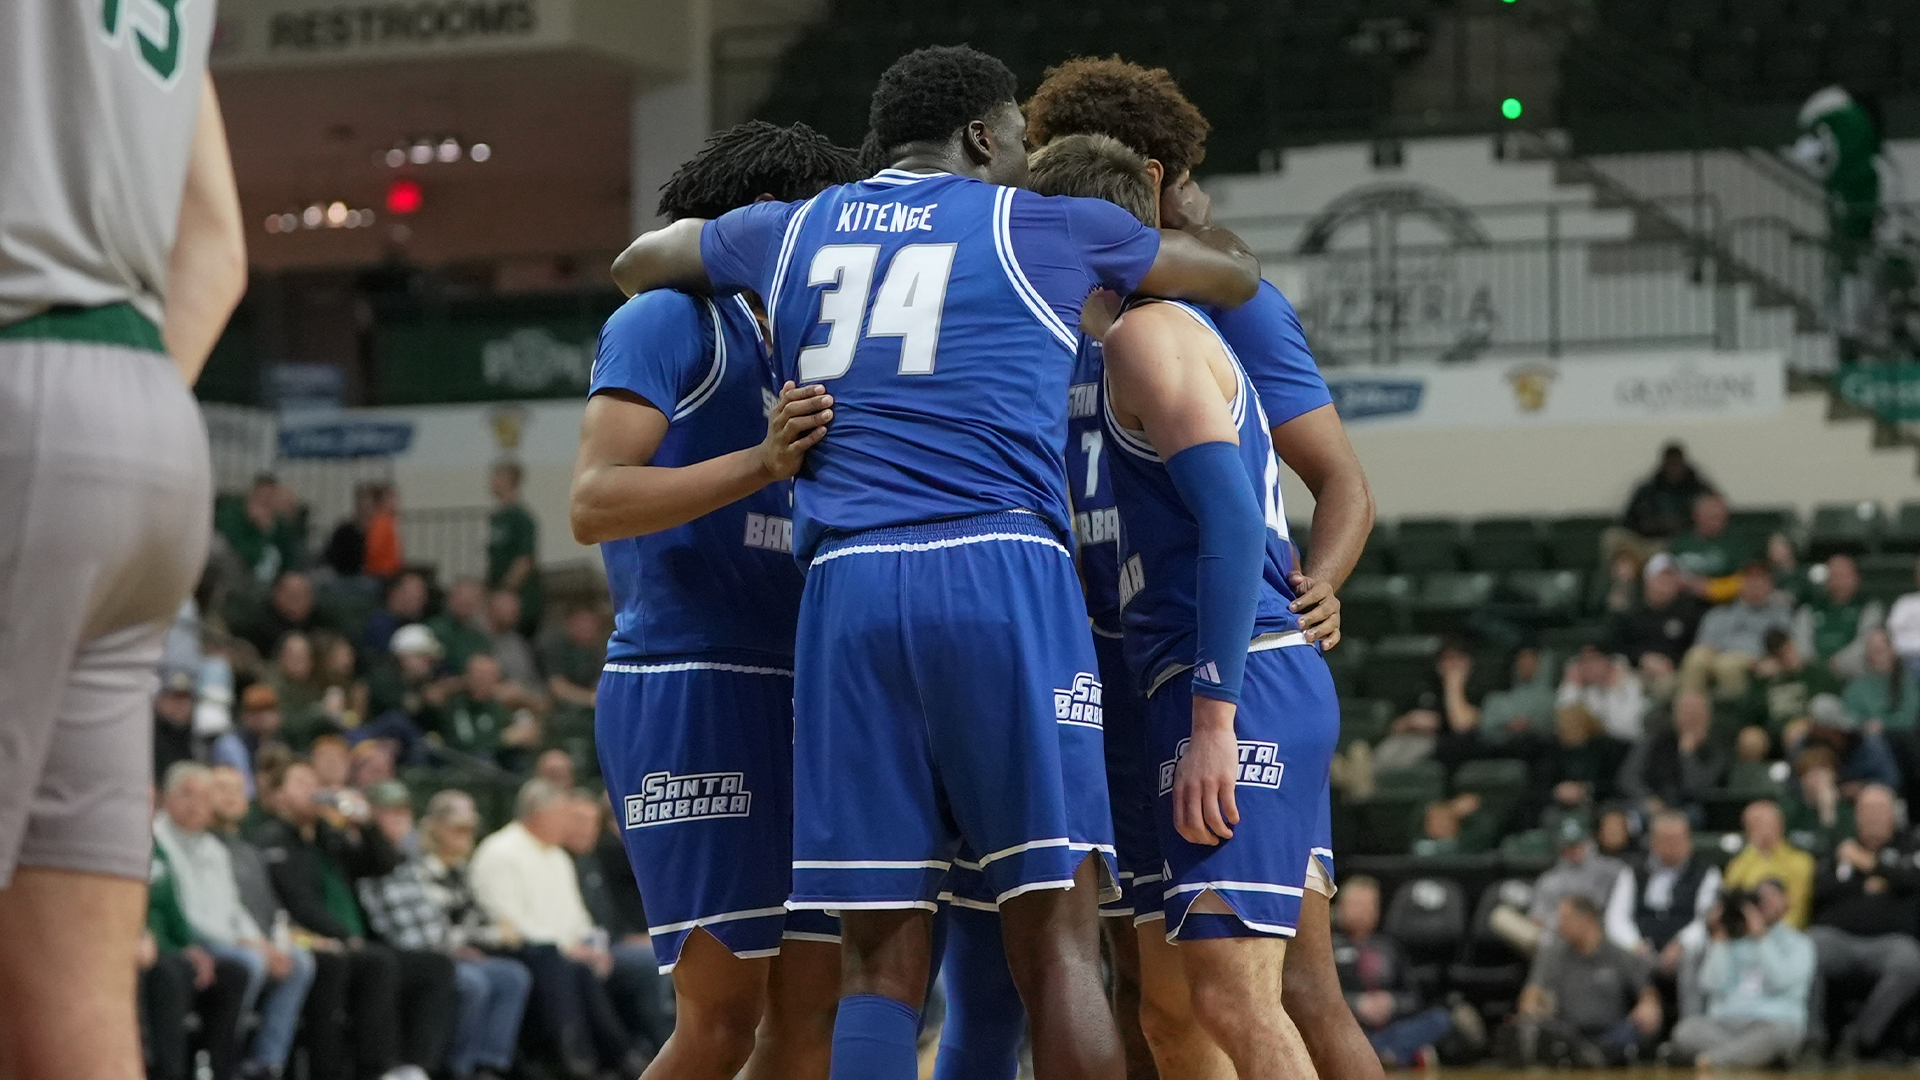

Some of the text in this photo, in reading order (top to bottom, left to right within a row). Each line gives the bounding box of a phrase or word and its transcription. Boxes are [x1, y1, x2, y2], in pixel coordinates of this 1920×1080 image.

[267, 0, 538, 48] RESTROOMS
[835, 201, 938, 233] KITENGE
[799, 242, 958, 384] 34
[1081, 430, 1104, 499] 7
[645, 775, 741, 803] SANTA
[627, 795, 747, 825] BARBARA
